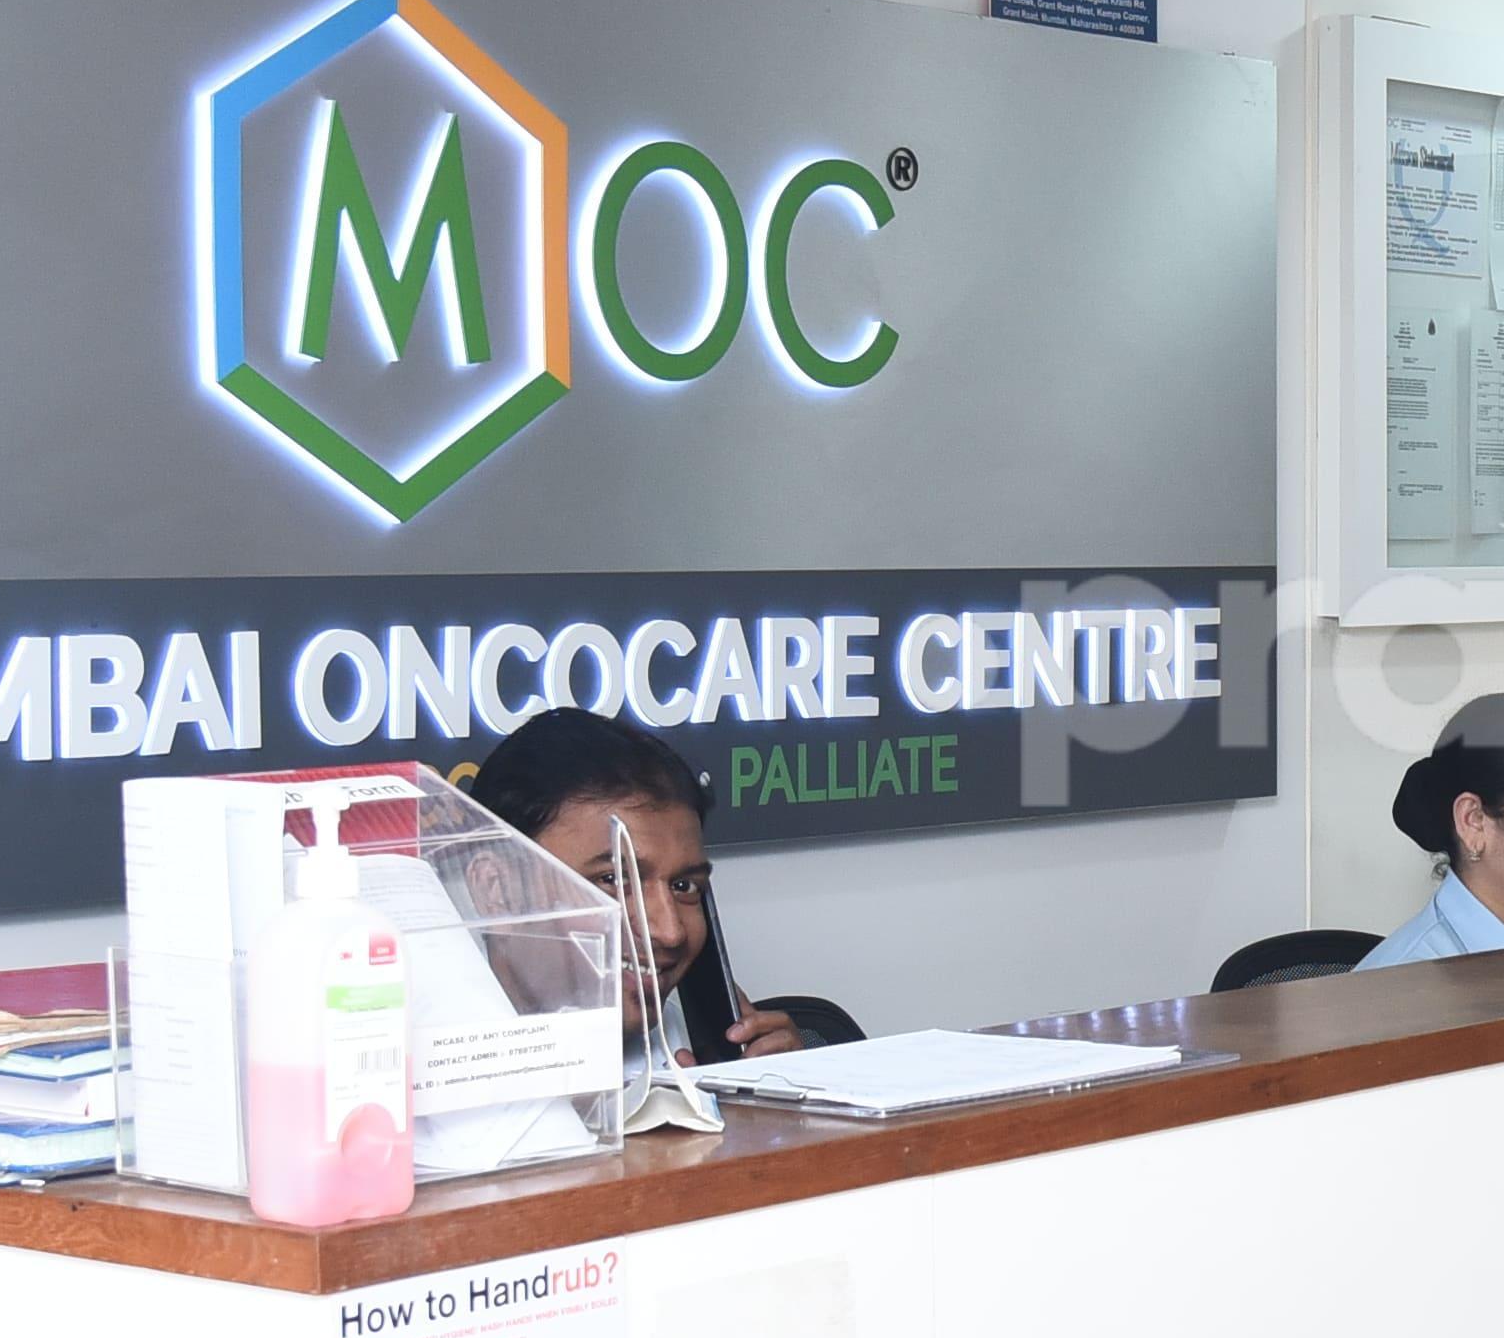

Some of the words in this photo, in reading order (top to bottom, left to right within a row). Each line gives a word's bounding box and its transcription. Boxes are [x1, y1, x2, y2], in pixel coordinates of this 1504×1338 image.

[294, 609, 882, 741] ONCOCARE
[900, 607, 1223, 715] CENTRE
[732, 734, 958, 808] PALLIATE
[427, 1056, 467, 1068] CONTACT
[341, 1301, 414, 1338] How
[426, 1290, 456, 1321] to
[469, 1251, 618, 1312] Handrub?
